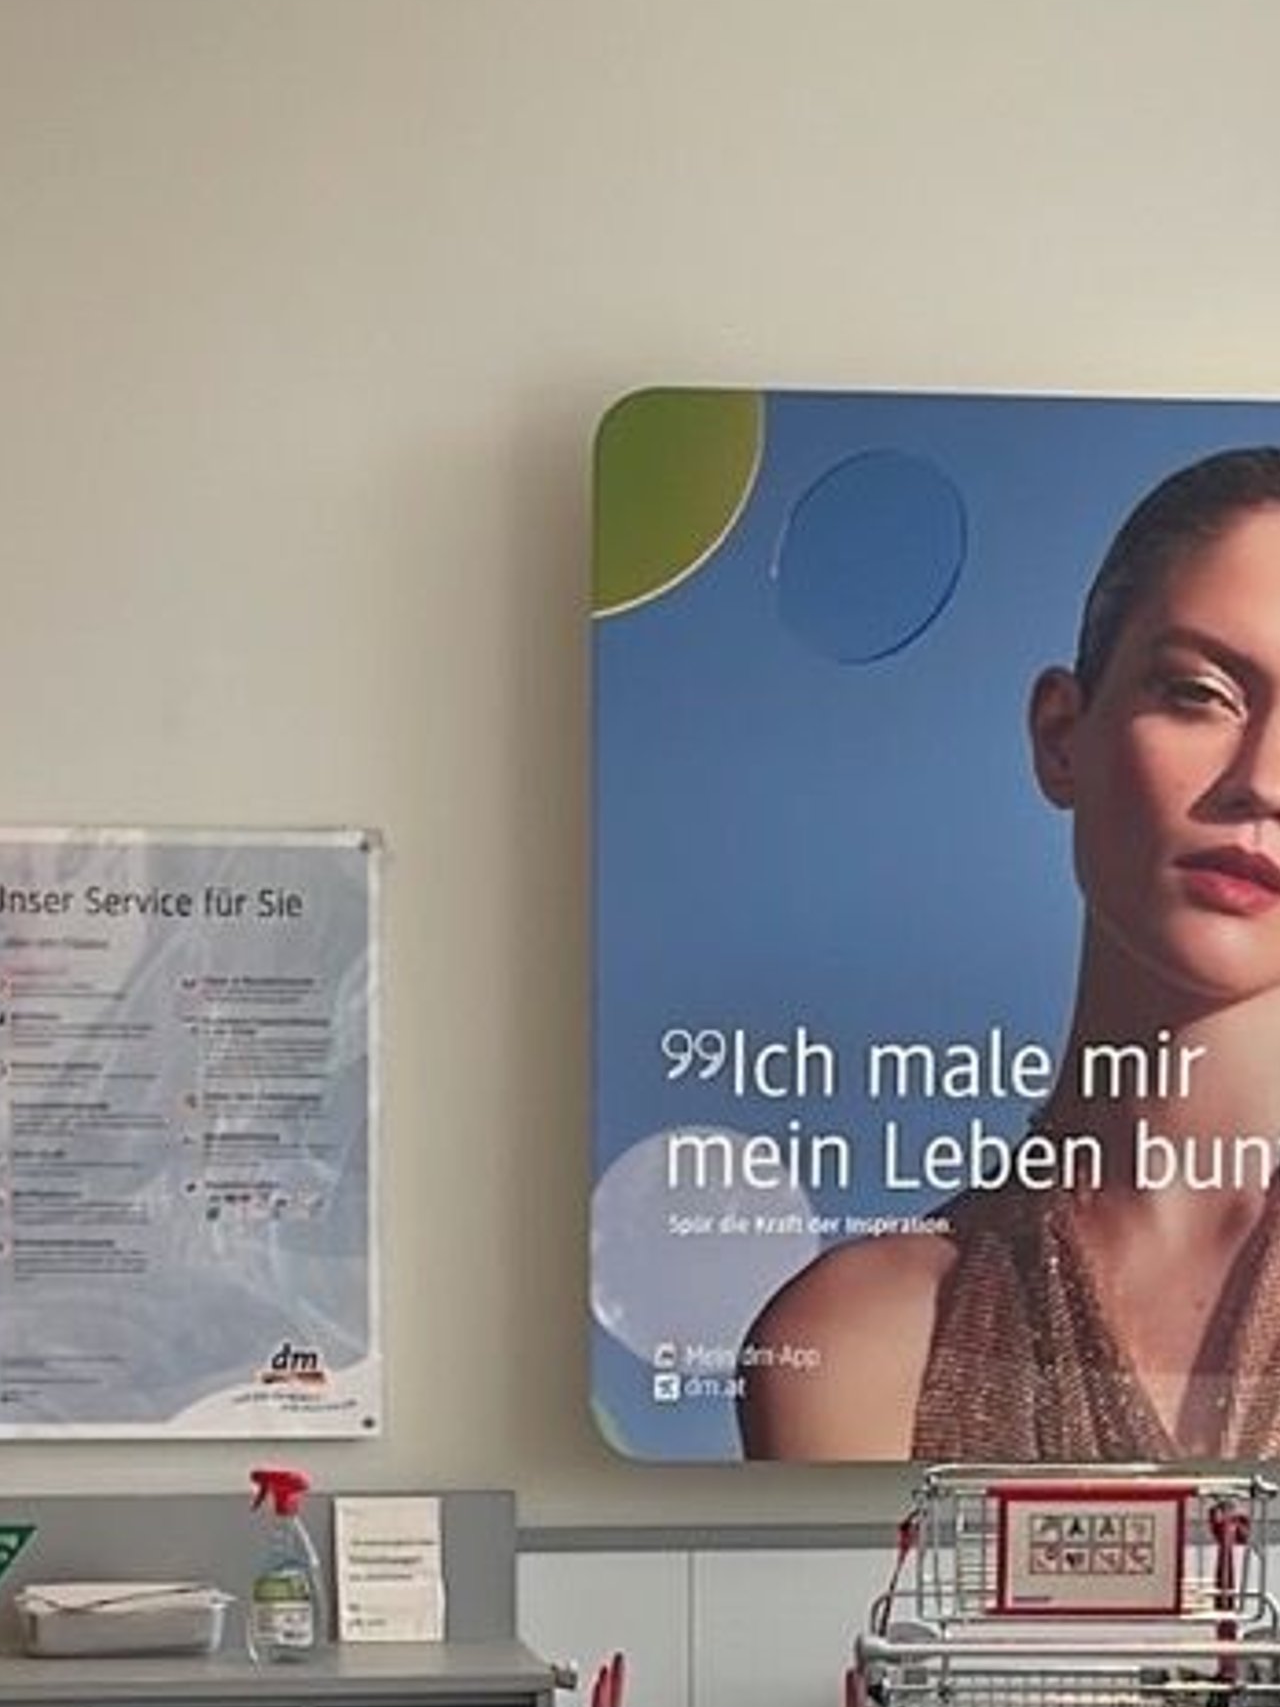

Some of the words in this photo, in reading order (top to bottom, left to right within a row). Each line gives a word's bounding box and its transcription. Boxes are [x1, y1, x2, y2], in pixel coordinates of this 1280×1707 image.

[85, 886, 193, 918] Service
[204, 886, 247, 918] für
[257, 889, 304, 919] Sie
[870, 1027, 1051, 1098] male
[1082, 1029, 1207, 1099] mir
[669, 1120, 849, 1190] mein
[885, 1118, 1102, 1190] Leben
[719, 1214, 749, 1234] die
[754, 1213, 803, 1234] Kraft
[808, 1214, 840, 1234] der
[271, 1342, 318, 1370] dm
